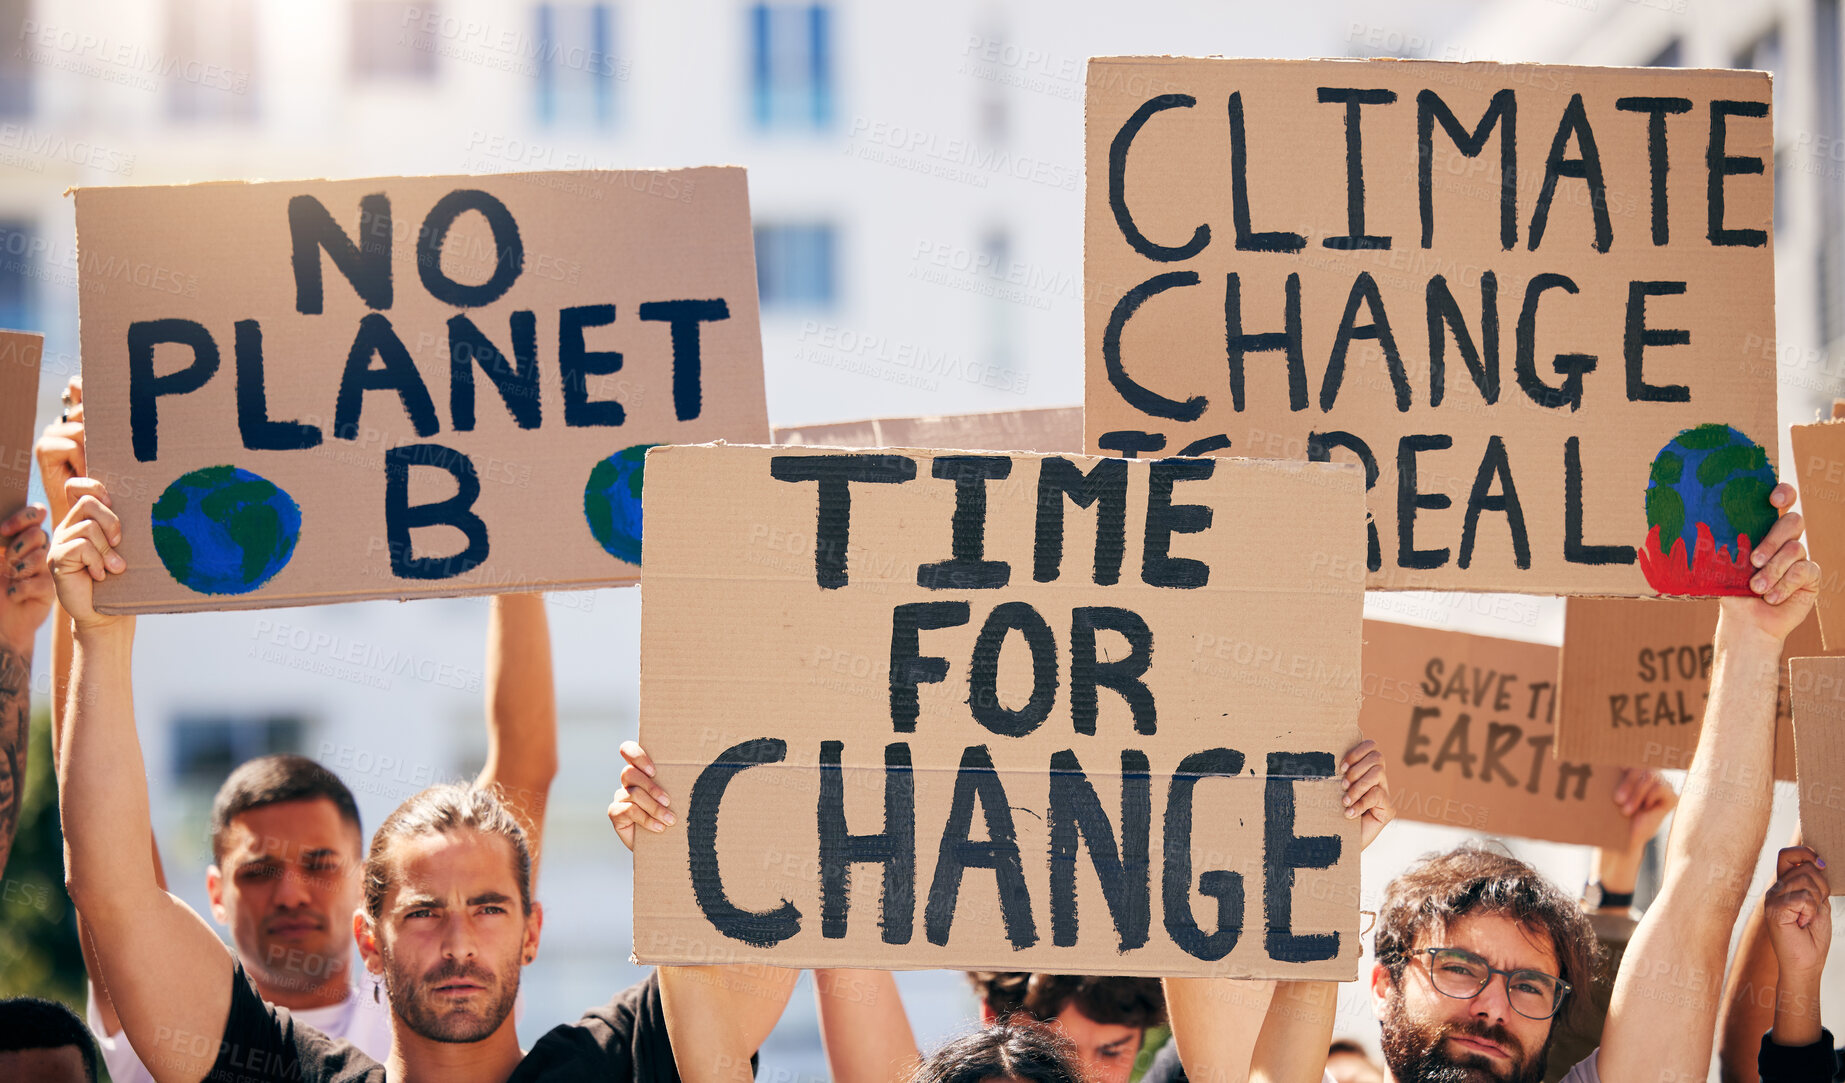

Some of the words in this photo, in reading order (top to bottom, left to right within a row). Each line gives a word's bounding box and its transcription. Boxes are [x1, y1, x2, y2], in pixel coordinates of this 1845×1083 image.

[1109, 86, 1770, 263] CLIMATE
[288, 190, 524, 315] NO
[128, 297, 731, 463] PLANET
[1103, 270, 1691, 422] CHANGE
[385, 443, 489, 580] B
[771, 455, 1216, 590] TIME
[888, 600, 1158, 738] FOR
[1420, 657, 1518, 712] SAVE
[1609, 690, 1694, 729] REAL
[1638, 643, 1715, 682] STOP
[687, 737, 1341, 964] CHANGE
